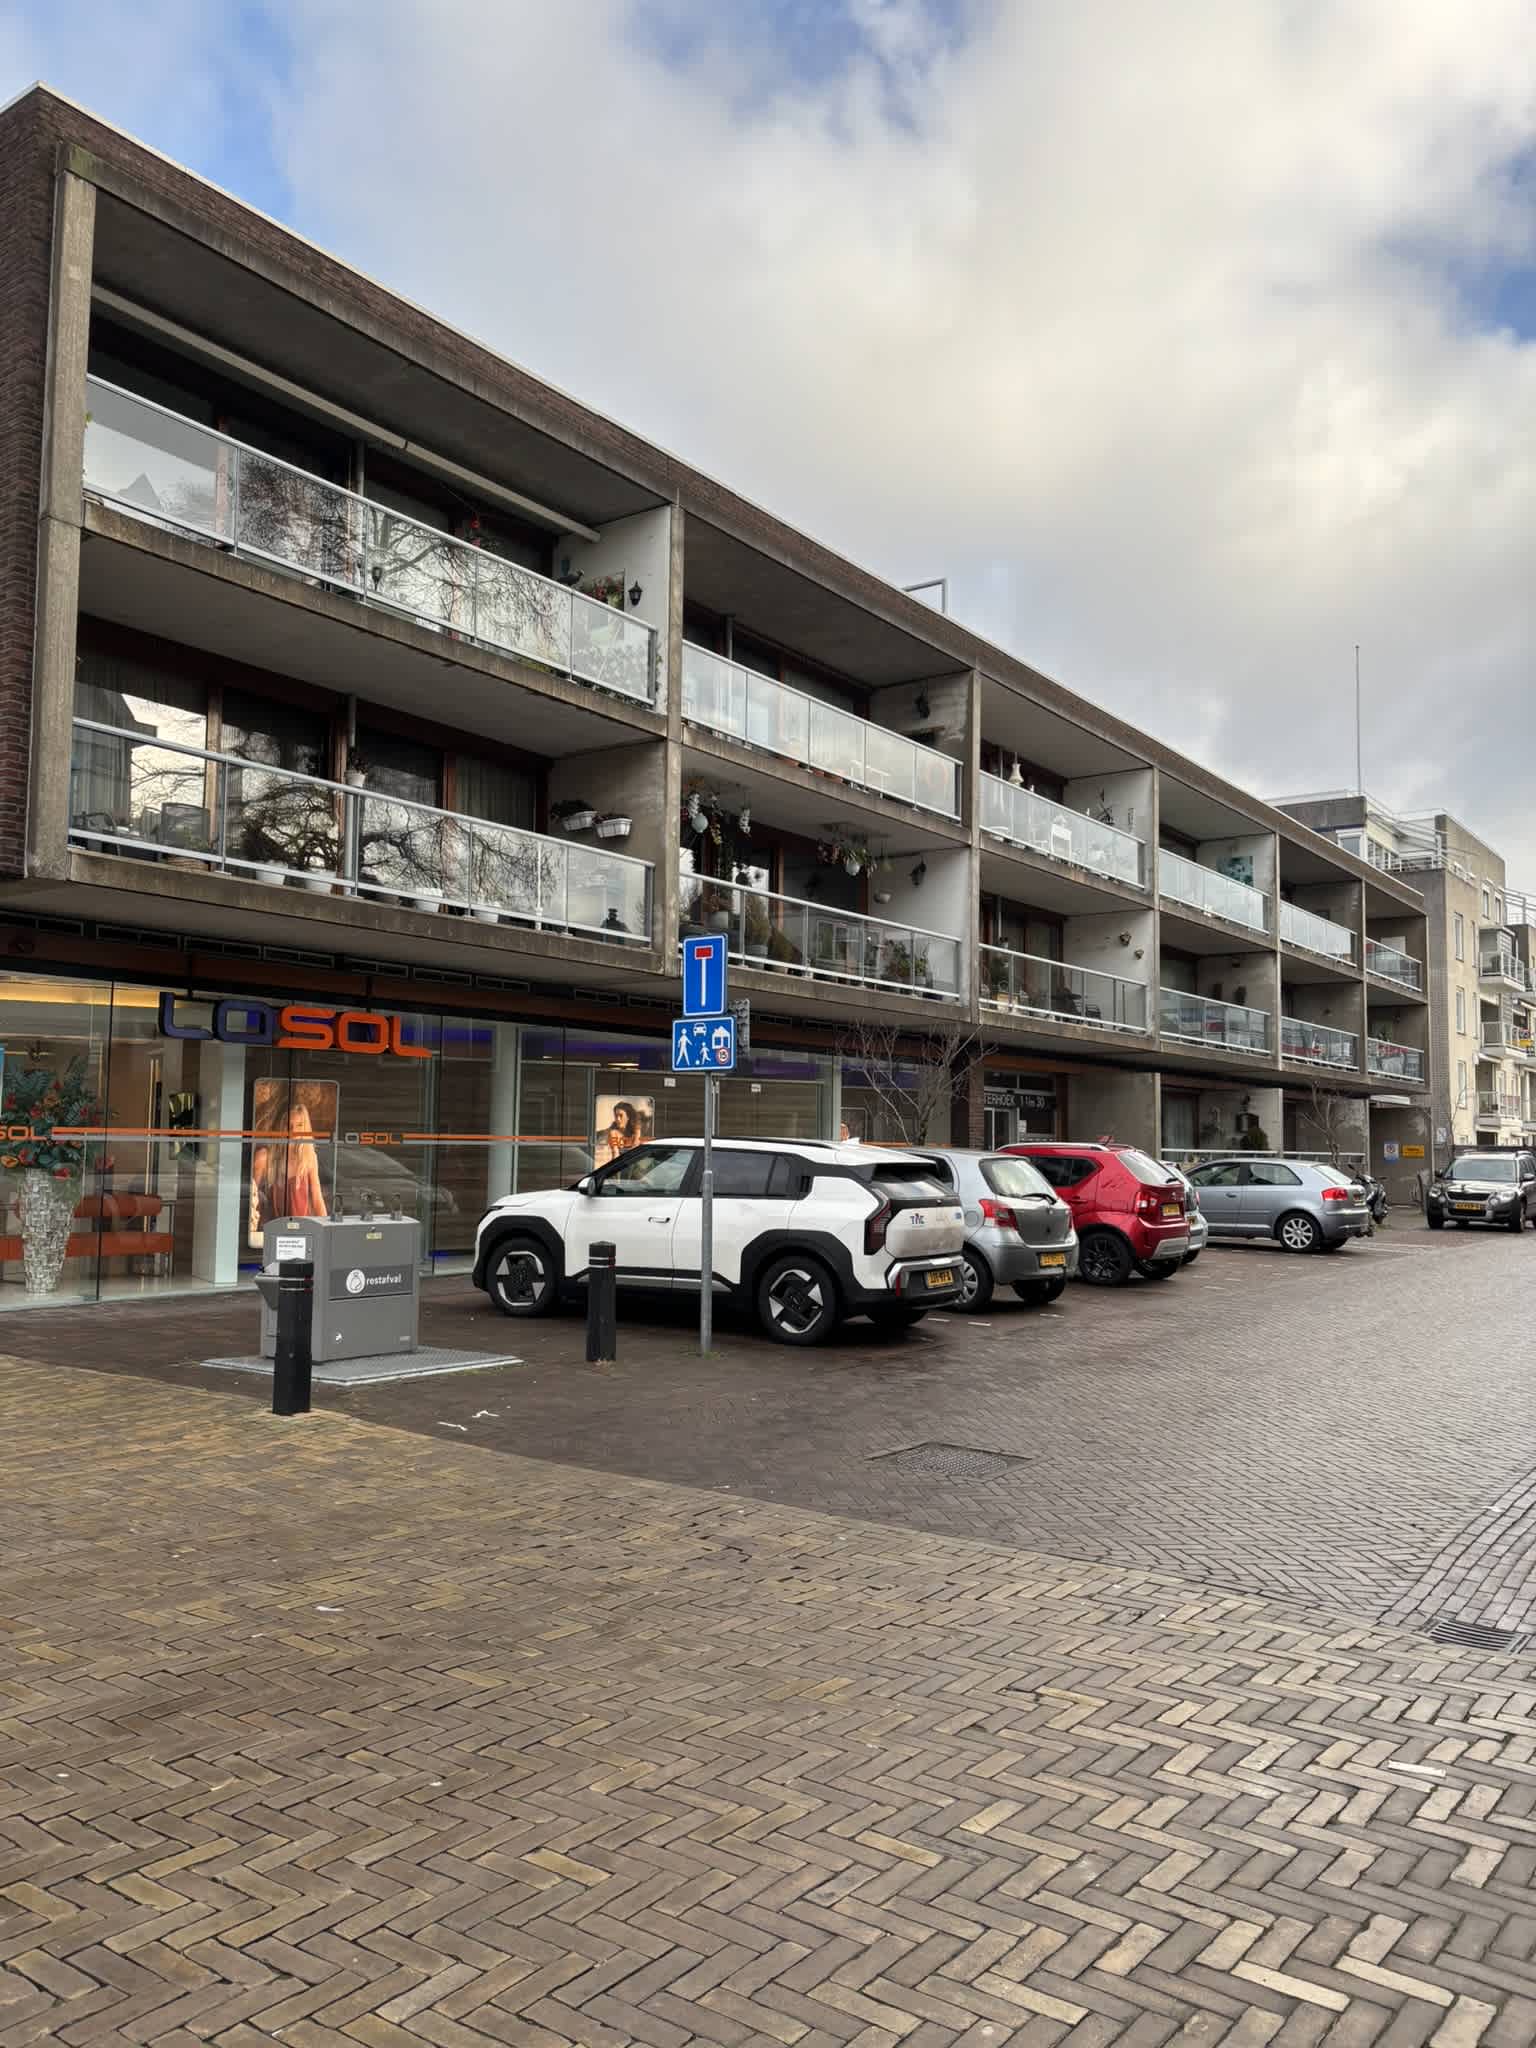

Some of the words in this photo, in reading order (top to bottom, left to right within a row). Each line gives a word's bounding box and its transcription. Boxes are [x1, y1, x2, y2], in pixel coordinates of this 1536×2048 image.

[159, 992, 432, 1058] LOSOL
[333, 1132, 401, 1145] LOSOL
[366, 1273, 402, 1286] restafval
